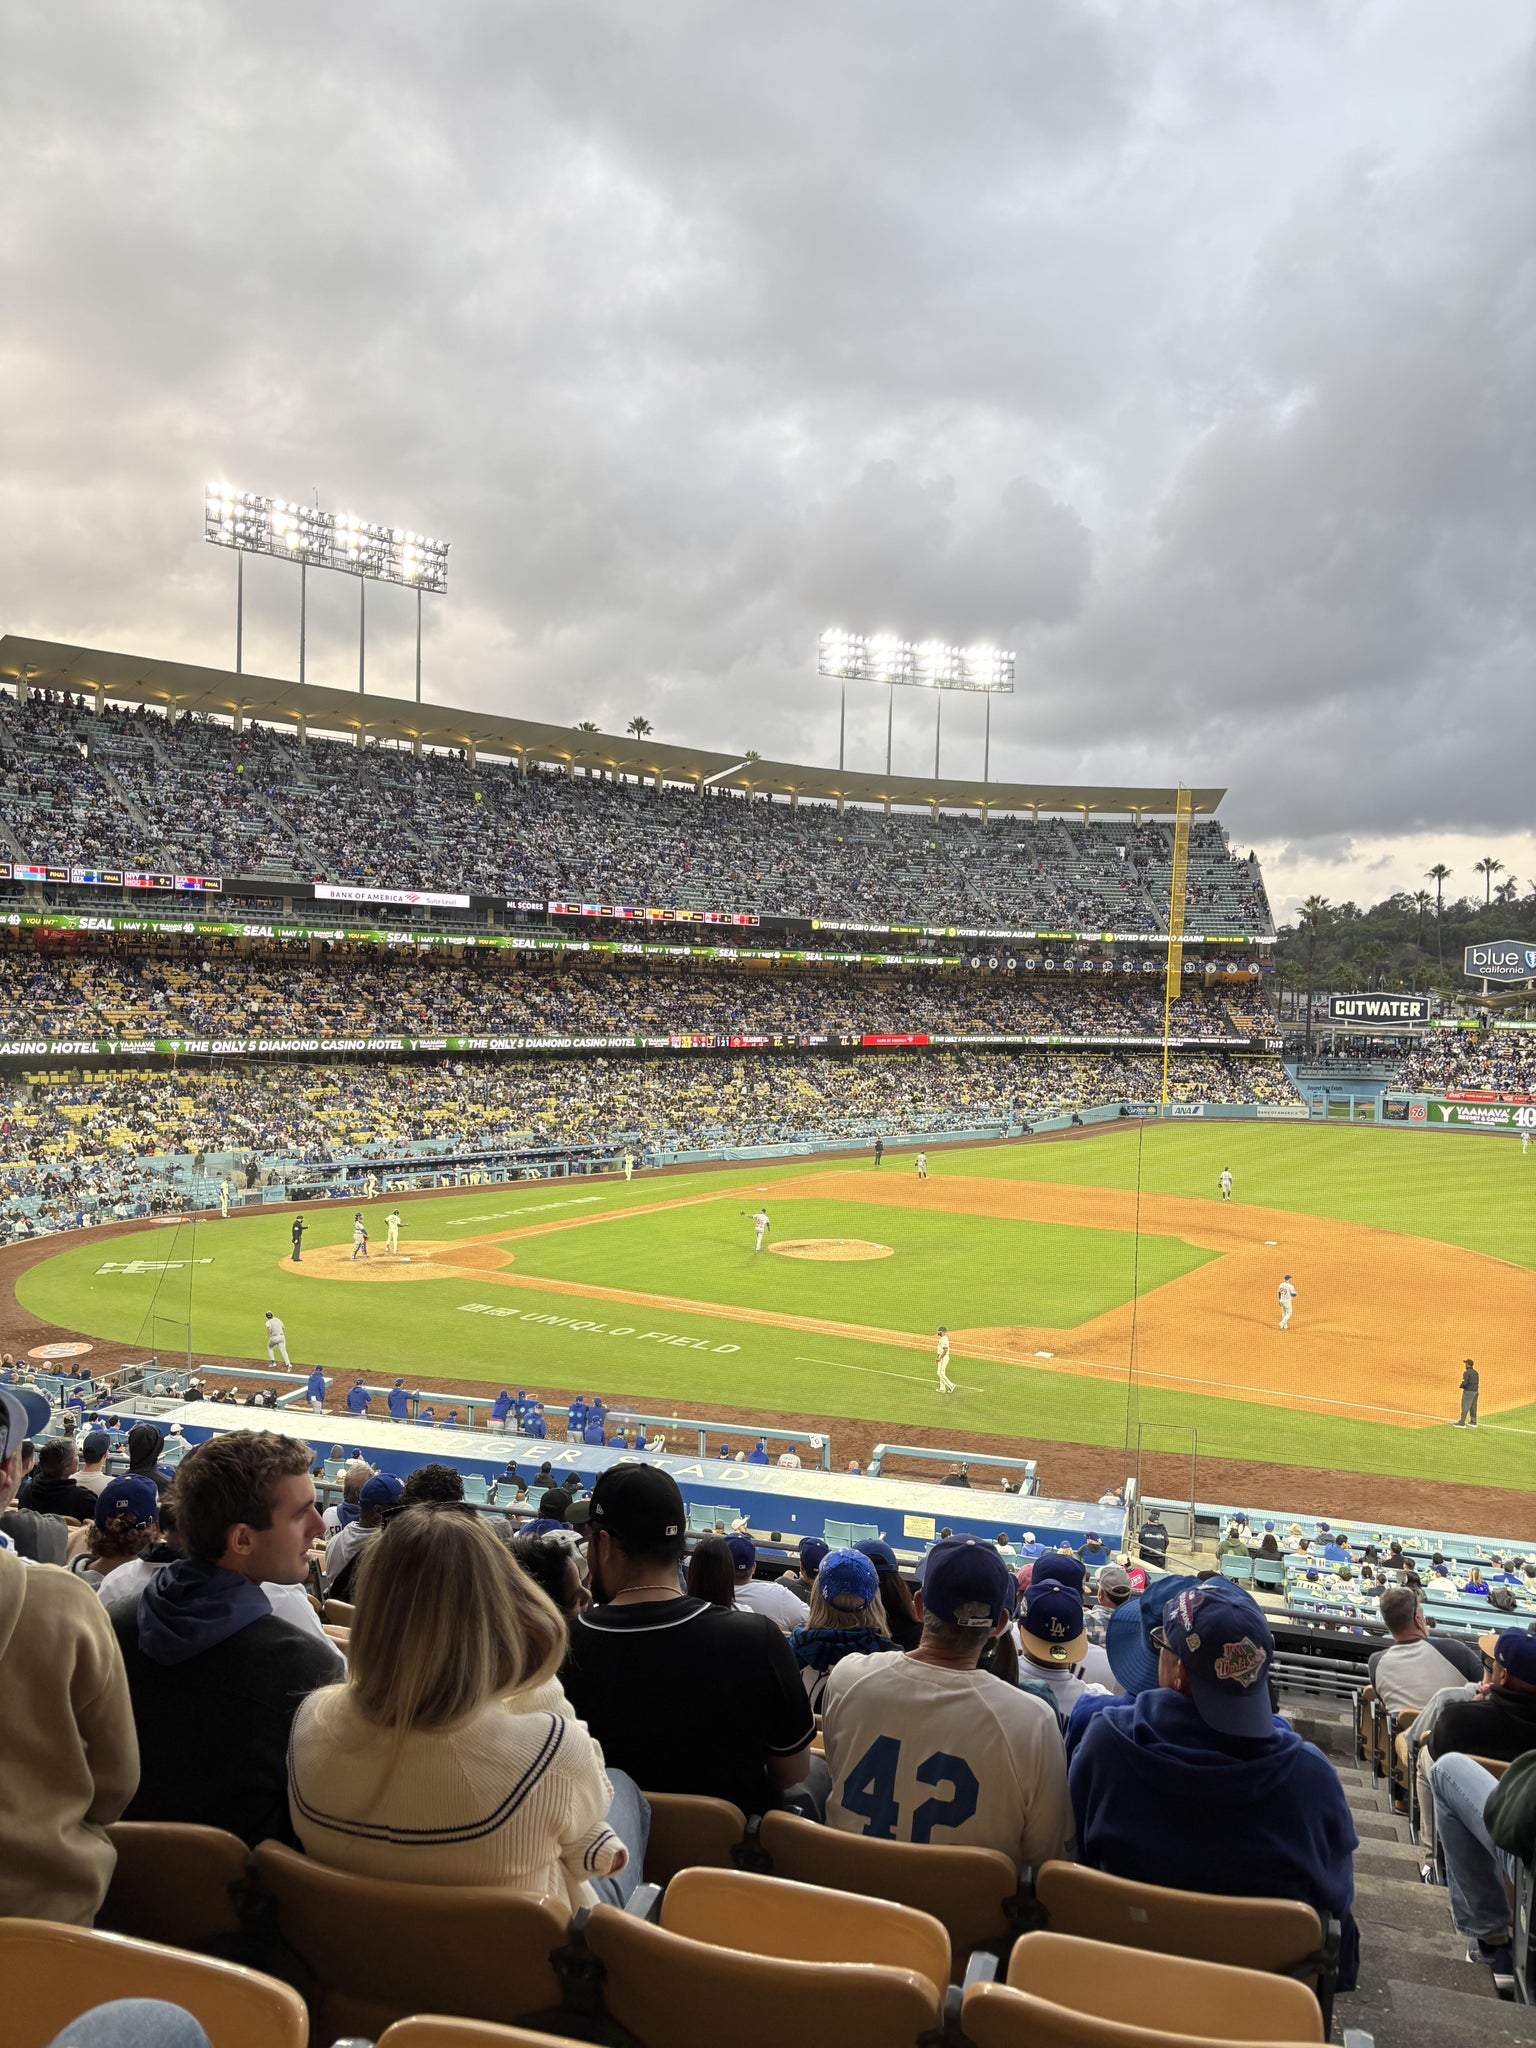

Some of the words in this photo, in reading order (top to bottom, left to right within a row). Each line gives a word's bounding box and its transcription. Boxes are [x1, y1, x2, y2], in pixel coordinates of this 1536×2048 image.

[159, 877, 165, 885] 9
[330, 890, 353, 899] BANK
[354, 892, 366, 901] OF
[367, 893, 403, 902] AMERICA
[506, 901, 516, 909] NL
[517, 901, 544, 910] SCORES
[79, 917, 116, 930] SEAL
[123, 922, 141, 930] MAY
[847, 923, 869, 931] CASINO
[242, 926, 275, 937] SEAL
[957, 929, 978, 937] VOTED
[987, 930, 1012, 938] CASINO
[386, 933, 414, 943] SEAL
[512, 940, 536, 949] SEAL
[621, 944, 644, 954] SEAL
[719, 948, 739, 957] SEAL
[806, 952, 823, 961] SEAL
[1473, 948, 1519, 966] blue
[886, 955, 902, 964] SEAL
[1479, 966, 1524, 974] california
[1335, 1001, 1421, 1017] CUTWATER
[50, 1042, 99, 1054] HOTEL
[183, 1041, 209, 1051] THE
[211, 1041, 247, 1052] ONLY
[247, 1041, 257, 1051] 5
[258, 1040, 319, 1050] DIAMOND
[320, 1040, 366, 1050] CASINO
[367, 1040, 404, 1050] HOTEL
[468, 1039, 488, 1048] THE
[489, 1039, 517, 1049] ONLY
[517, 1040, 523, 1048] 5
[525, 1039, 572, 1048] DIAMOND
[573, 1038, 608, 1047] CASINO
[608, 1038, 636, 1047] HOTEL
[1268, 1040, 1283, 1048] 7:12
[1412, 1108, 1424, 1117] 76
[1456, 1106, 1511, 1117] YAAMAVA'
[519, 1312, 636, 1336] UNIQLO
[636, 1331, 742, 1354] FIELD
[1049, 1616, 1066, 1637] LA
[1215, 1658, 1247, 1679] World
[841, 1734, 980, 1845] 42
